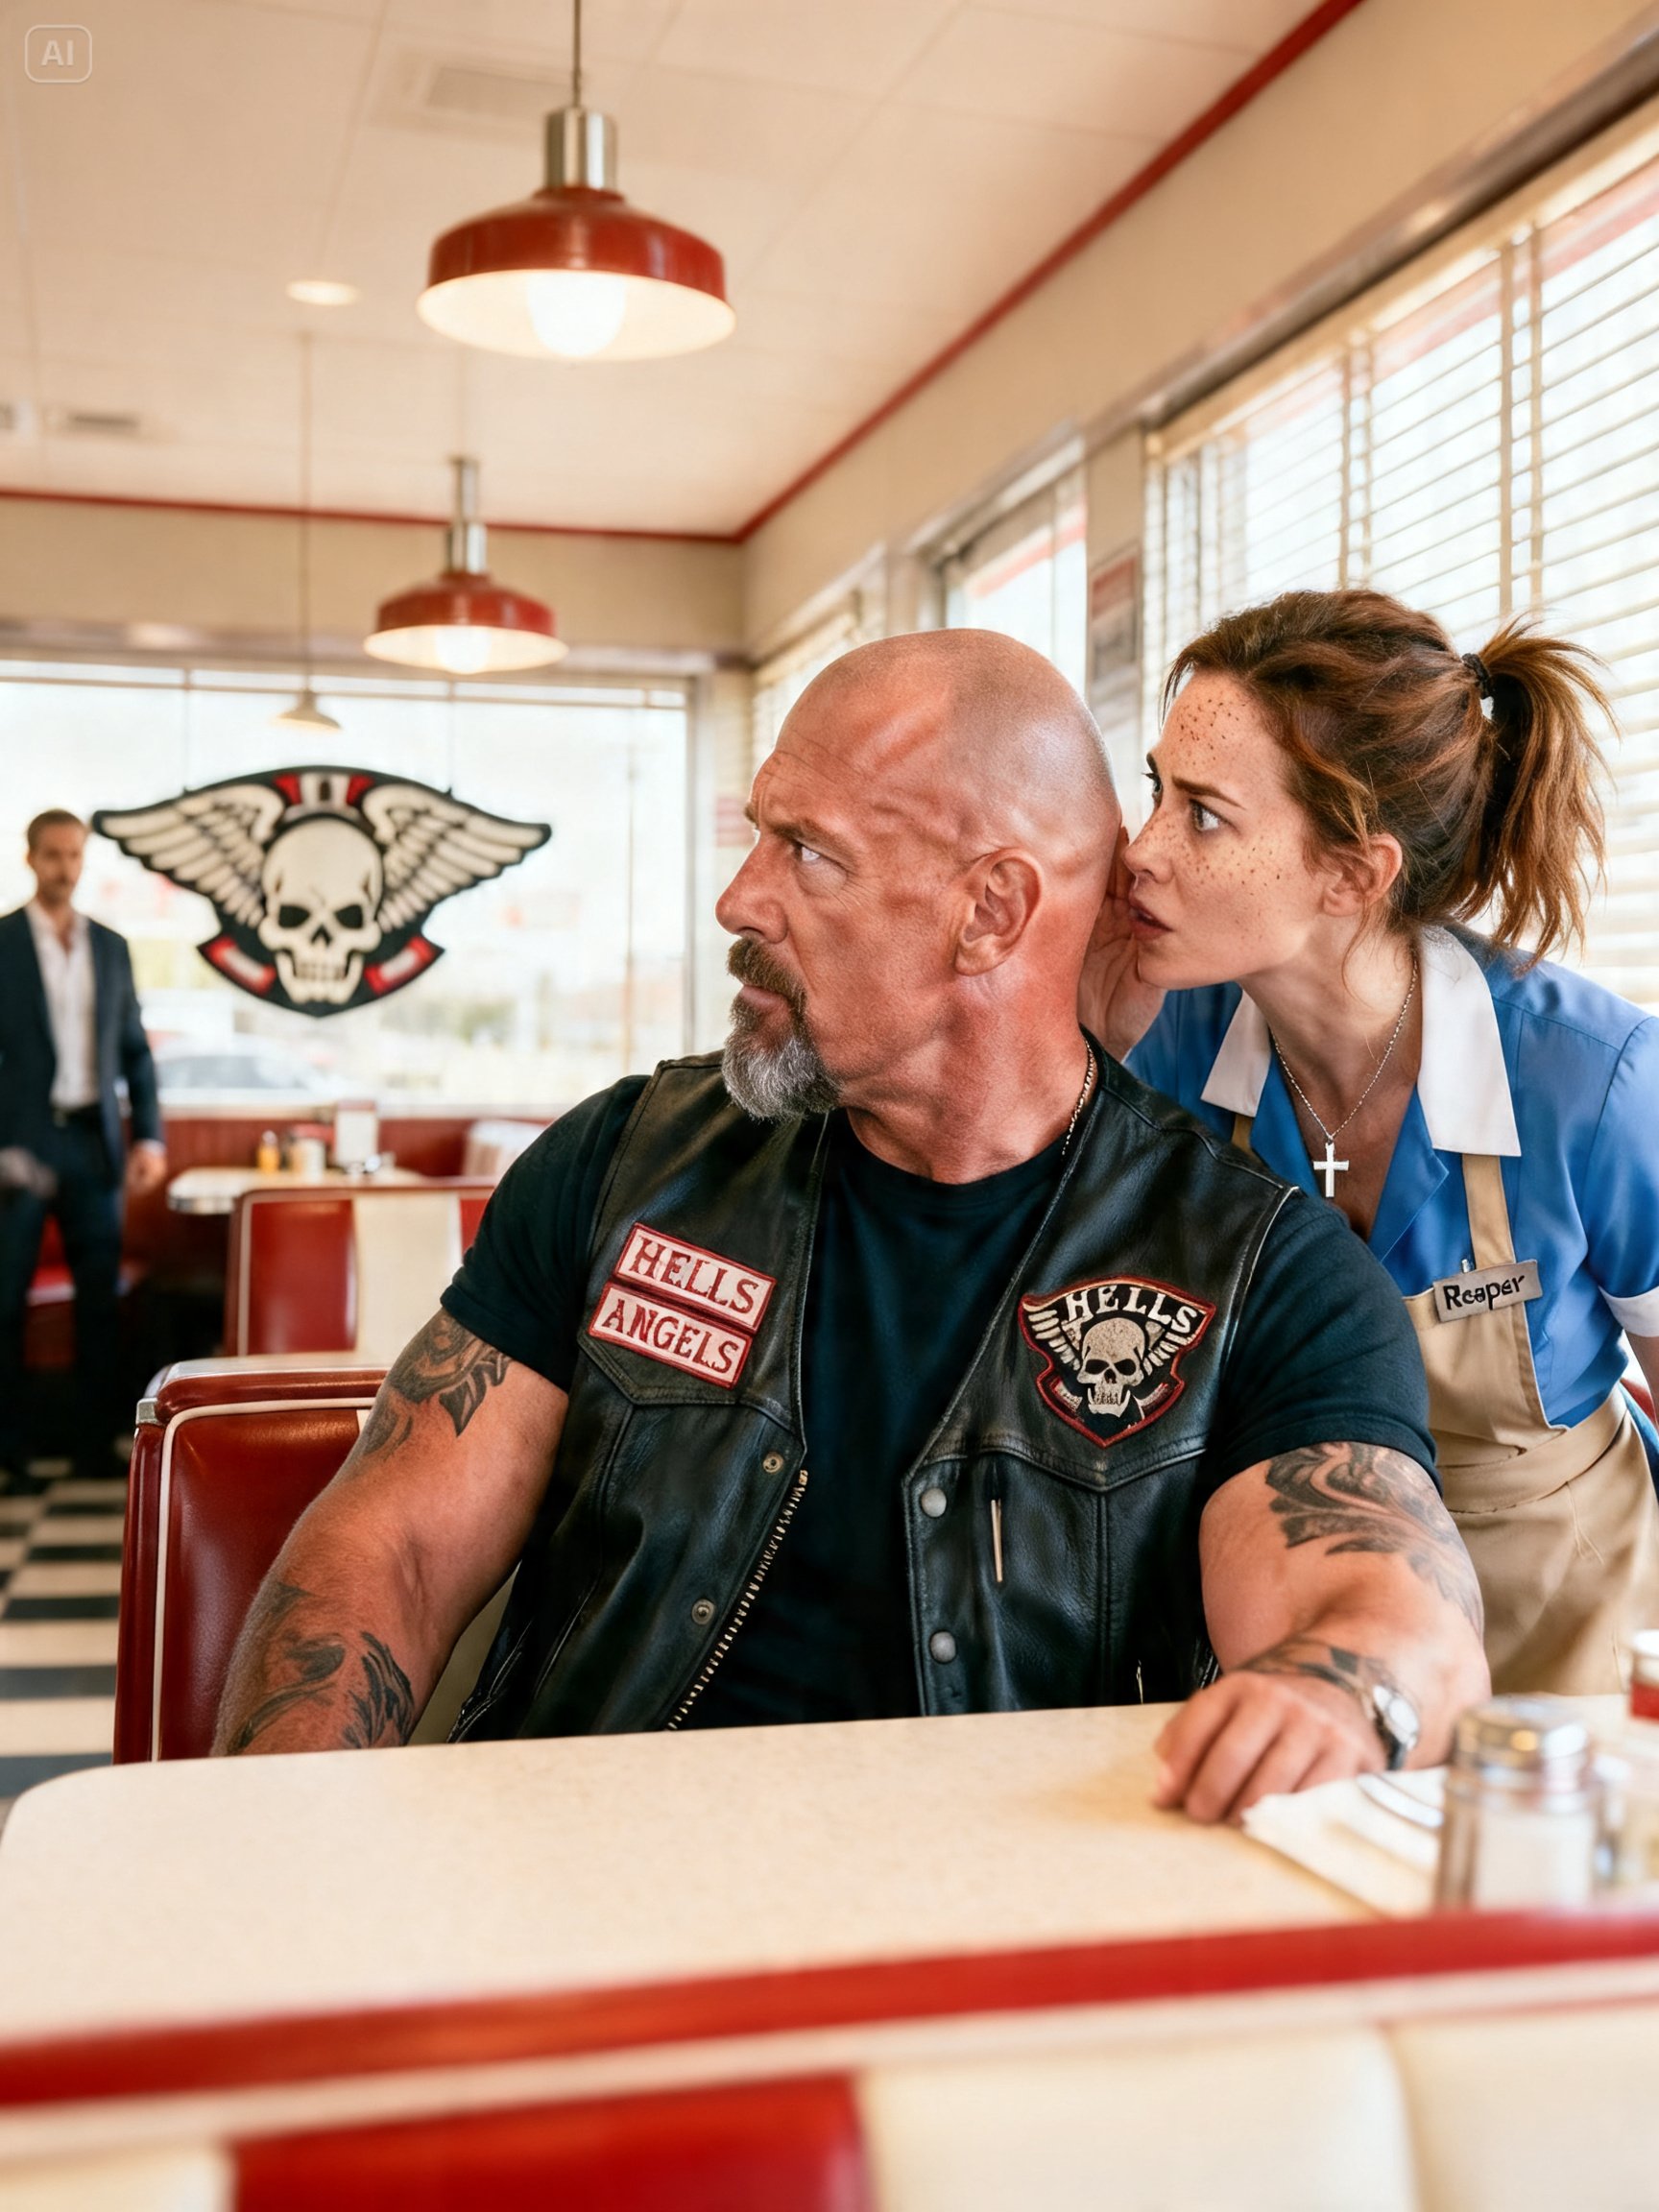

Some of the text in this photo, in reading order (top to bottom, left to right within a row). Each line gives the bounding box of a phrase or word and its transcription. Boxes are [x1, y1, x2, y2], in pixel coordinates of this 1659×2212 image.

[629, 1236, 758, 1314] HELLS
[1442, 1275, 1526, 1310] Reaper
[601, 1298, 739, 1374] ANGELS
[1065, 1285, 1198, 1334] HELLS
